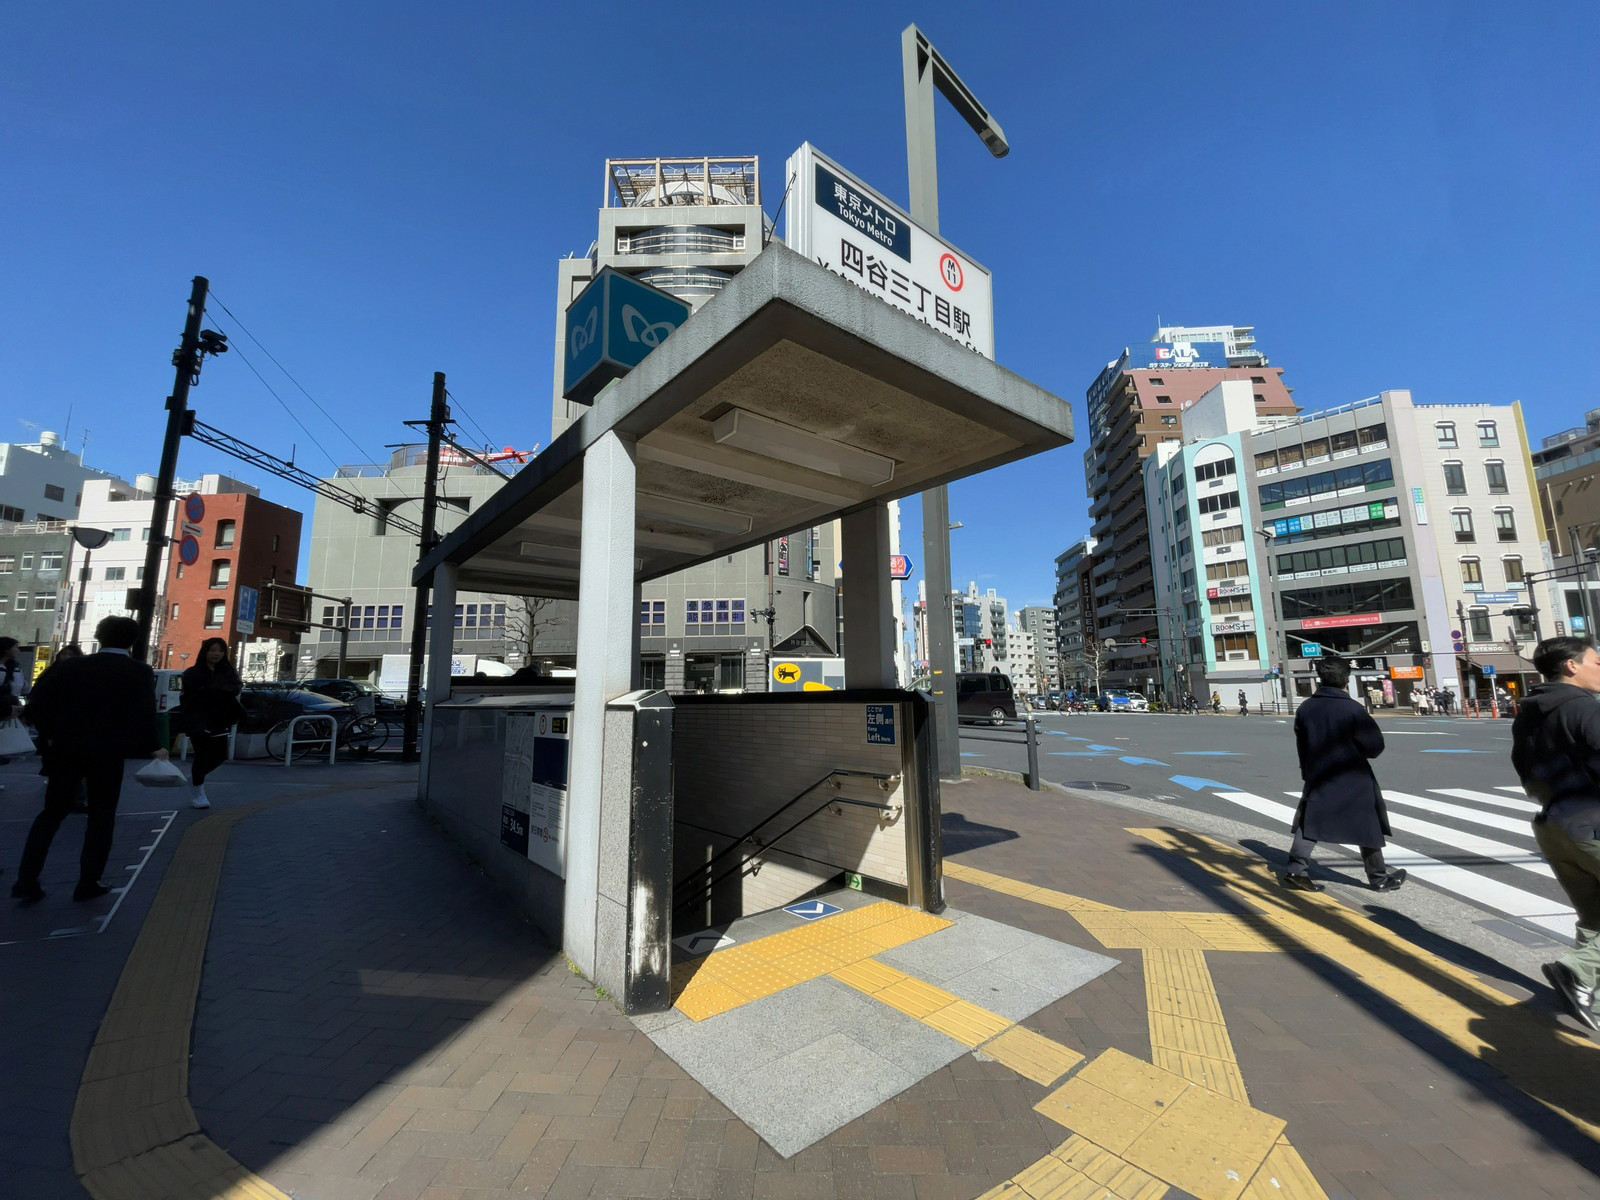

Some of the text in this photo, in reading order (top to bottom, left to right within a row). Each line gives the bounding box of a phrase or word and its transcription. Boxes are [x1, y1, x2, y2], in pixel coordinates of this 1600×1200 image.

[833, 181, 896, 236] 東京メトロ
[837, 202, 893, 247] Tokyo Metro
[947, 259, 956, 273] M
[947, 269, 957, 285] 11
[841, 237, 972, 339] 四谷三丁目駅
[1157, 347, 1199, 359] GALA
[1083, 595, 1094, 633] TIGER
[867, 732, 881, 742] Left
